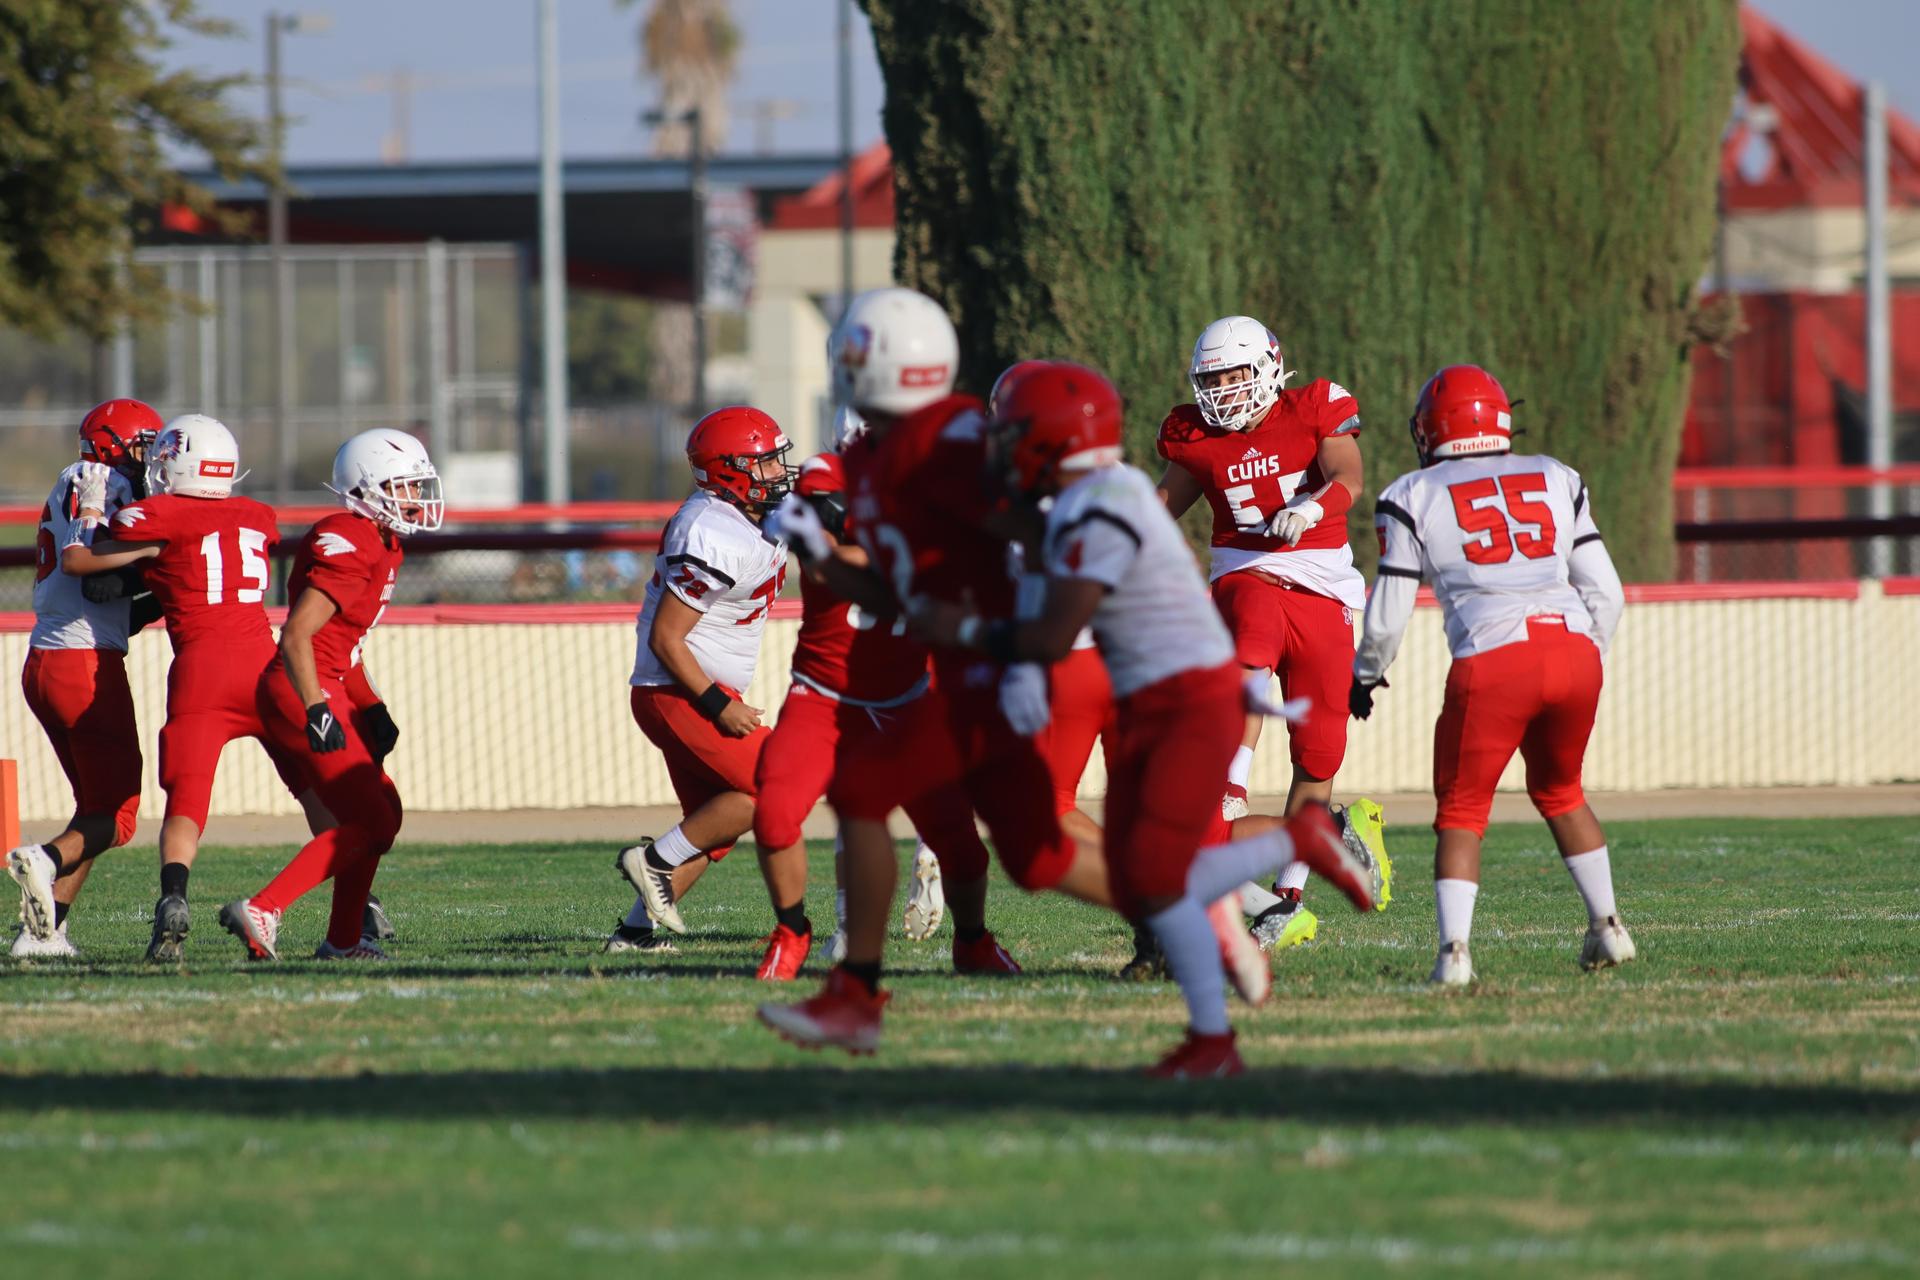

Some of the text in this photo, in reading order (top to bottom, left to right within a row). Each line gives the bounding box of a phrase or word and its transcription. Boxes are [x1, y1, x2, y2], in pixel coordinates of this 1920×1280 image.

[1227, 455, 1280, 483] CUHS
[1452, 437, 1500, 453] Riddell
[1448, 472, 1556, 565] 55
[200, 526, 269, 605] 15
